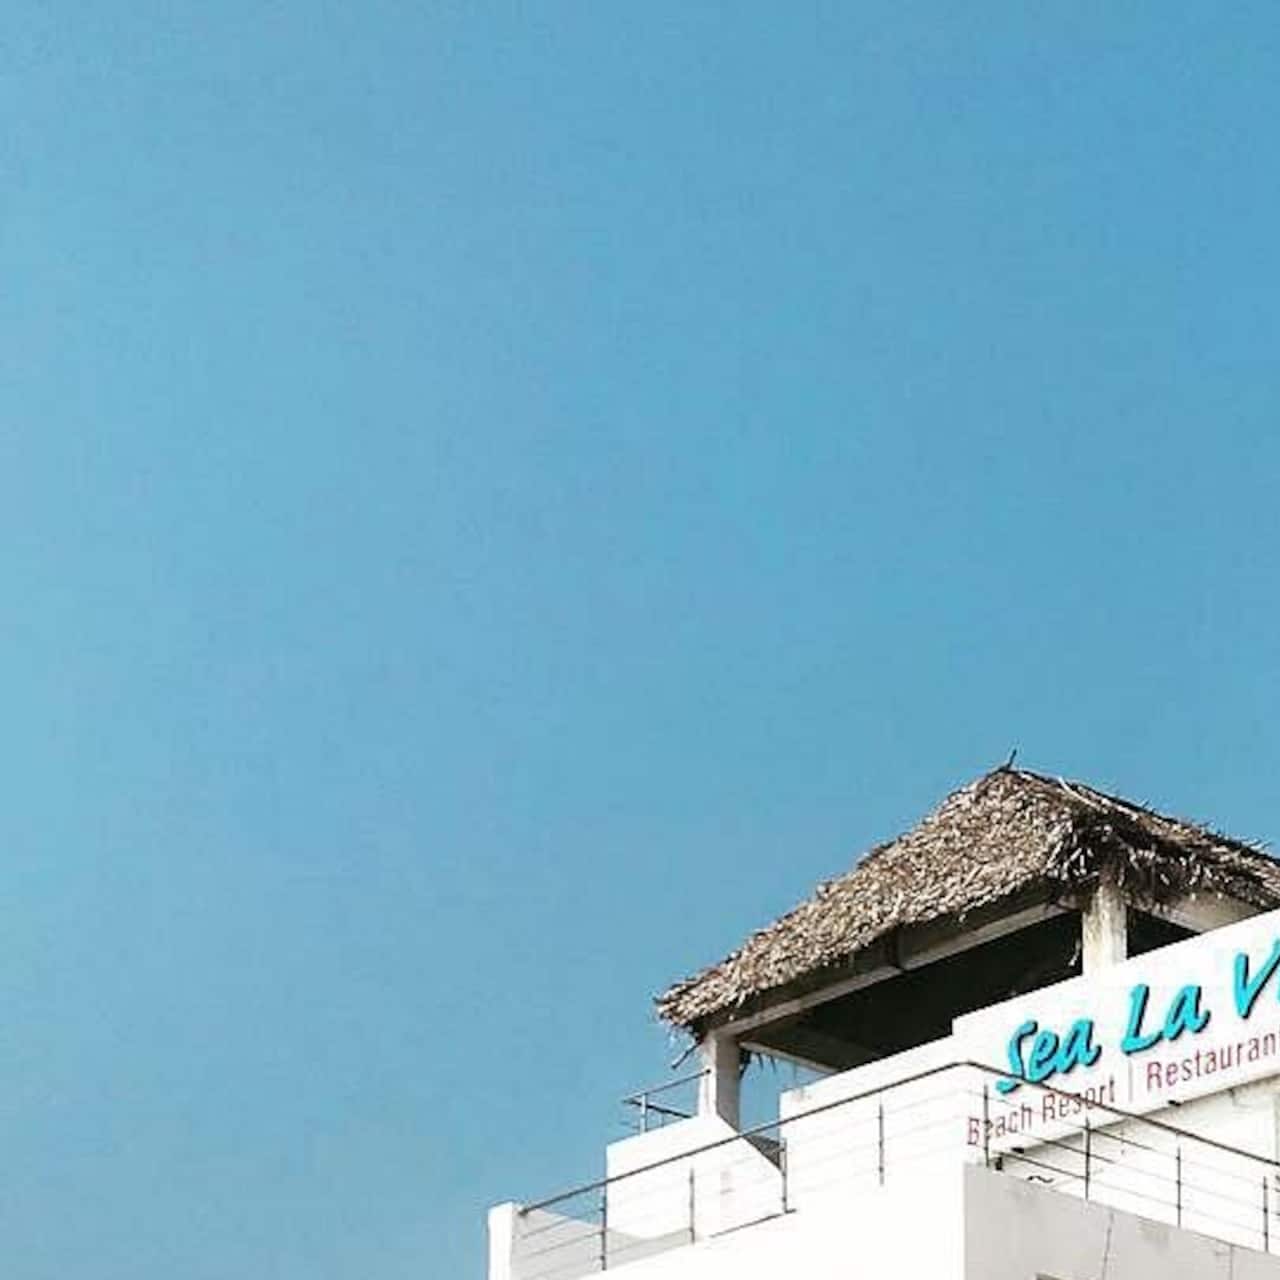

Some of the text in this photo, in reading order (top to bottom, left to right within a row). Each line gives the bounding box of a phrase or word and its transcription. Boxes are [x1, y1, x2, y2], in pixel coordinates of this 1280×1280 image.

[996, 1020, 1102, 1094] Sea
[1121, 984, 1211, 1055] La
[967, 1103, 1032, 1146] Beach
[1042, 1076, 1115, 1123] Resort
